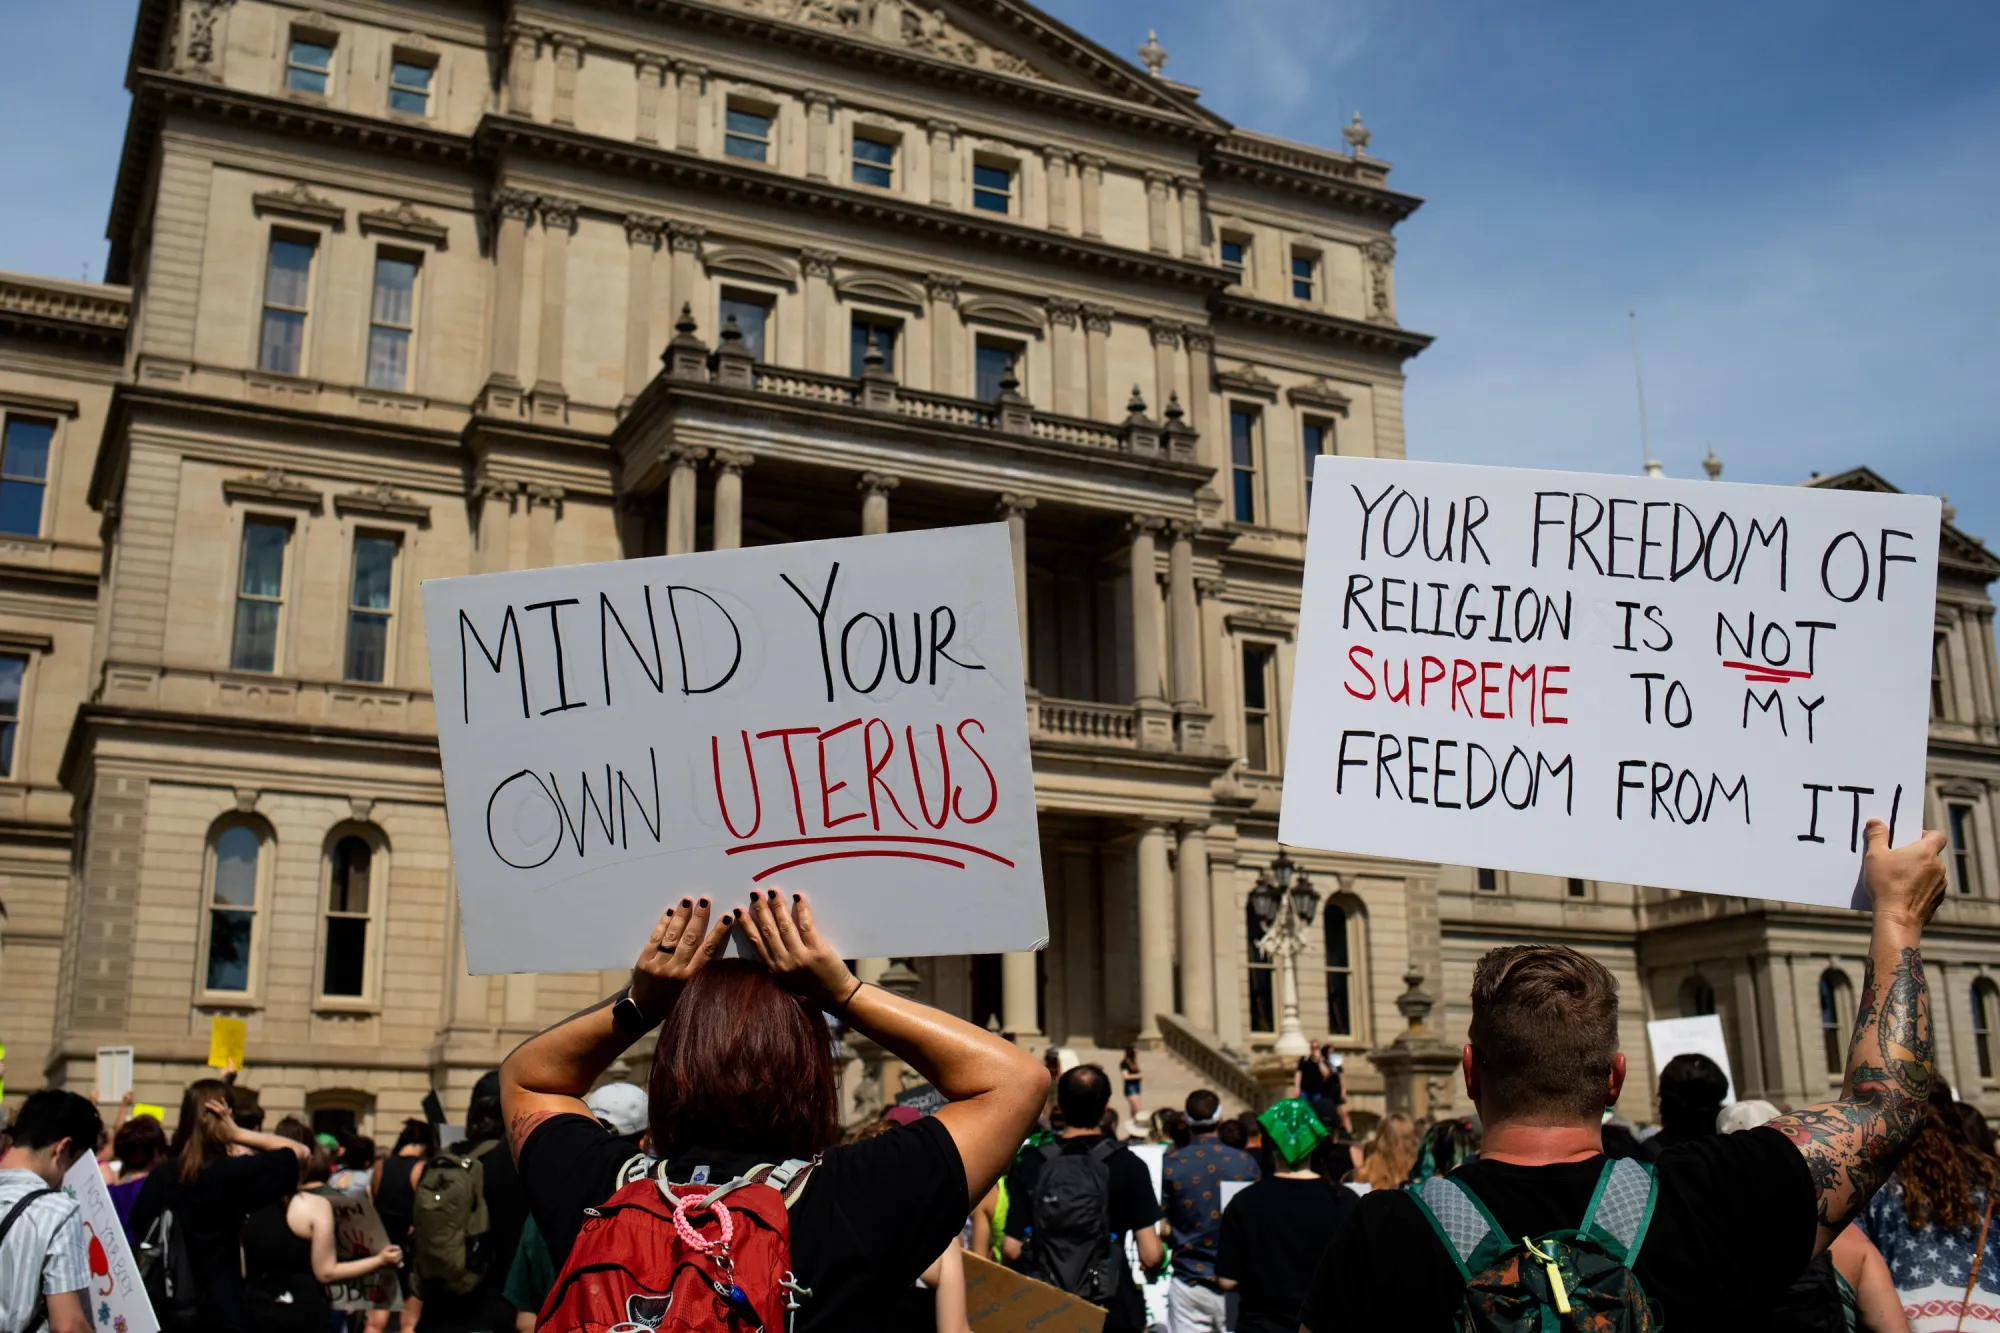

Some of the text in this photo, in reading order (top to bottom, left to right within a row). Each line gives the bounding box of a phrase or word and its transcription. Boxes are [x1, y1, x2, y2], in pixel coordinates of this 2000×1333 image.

[1351, 484, 1917, 603] YOUR FREEDOM OF
[460, 561, 987, 724] MIND YOUR
[1342, 574, 1837, 676] RELIGION IS NOT
[1343, 645, 1826, 744] SUPREME TO MY
[487, 717, 998, 869] OWN UTERUS
[1336, 730, 1572, 816] FREEDOM
[1617, 759, 1750, 825] FROM
